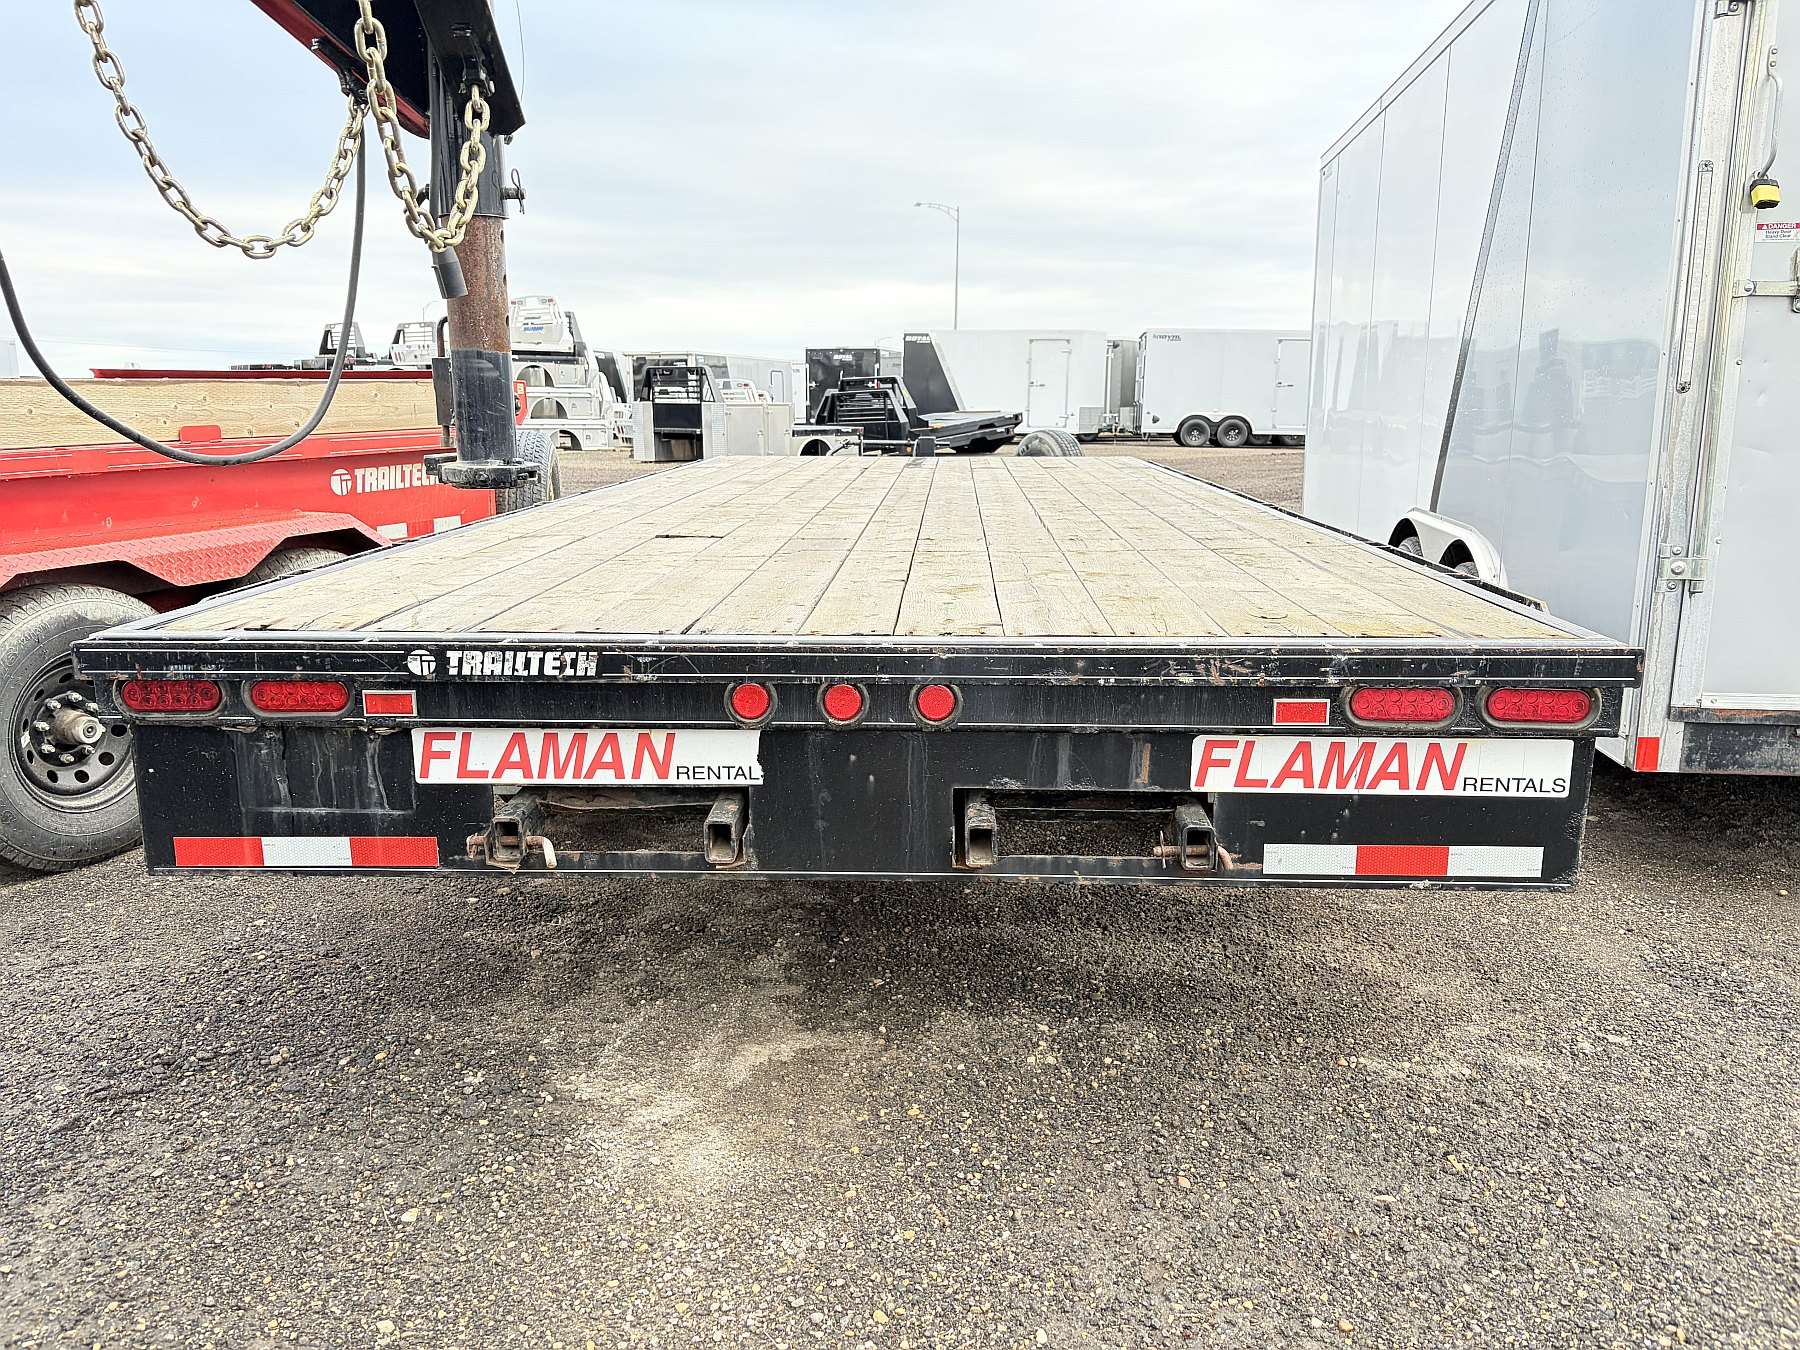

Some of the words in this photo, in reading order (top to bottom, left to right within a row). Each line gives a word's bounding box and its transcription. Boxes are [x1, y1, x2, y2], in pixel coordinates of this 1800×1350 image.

[419, 731, 677, 780] FLAMAN
[676, 766, 764, 781] RENTAL
[1194, 739, 1468, 791] FLAMAN
[1462, 777, 1568, 793] RENTALS
